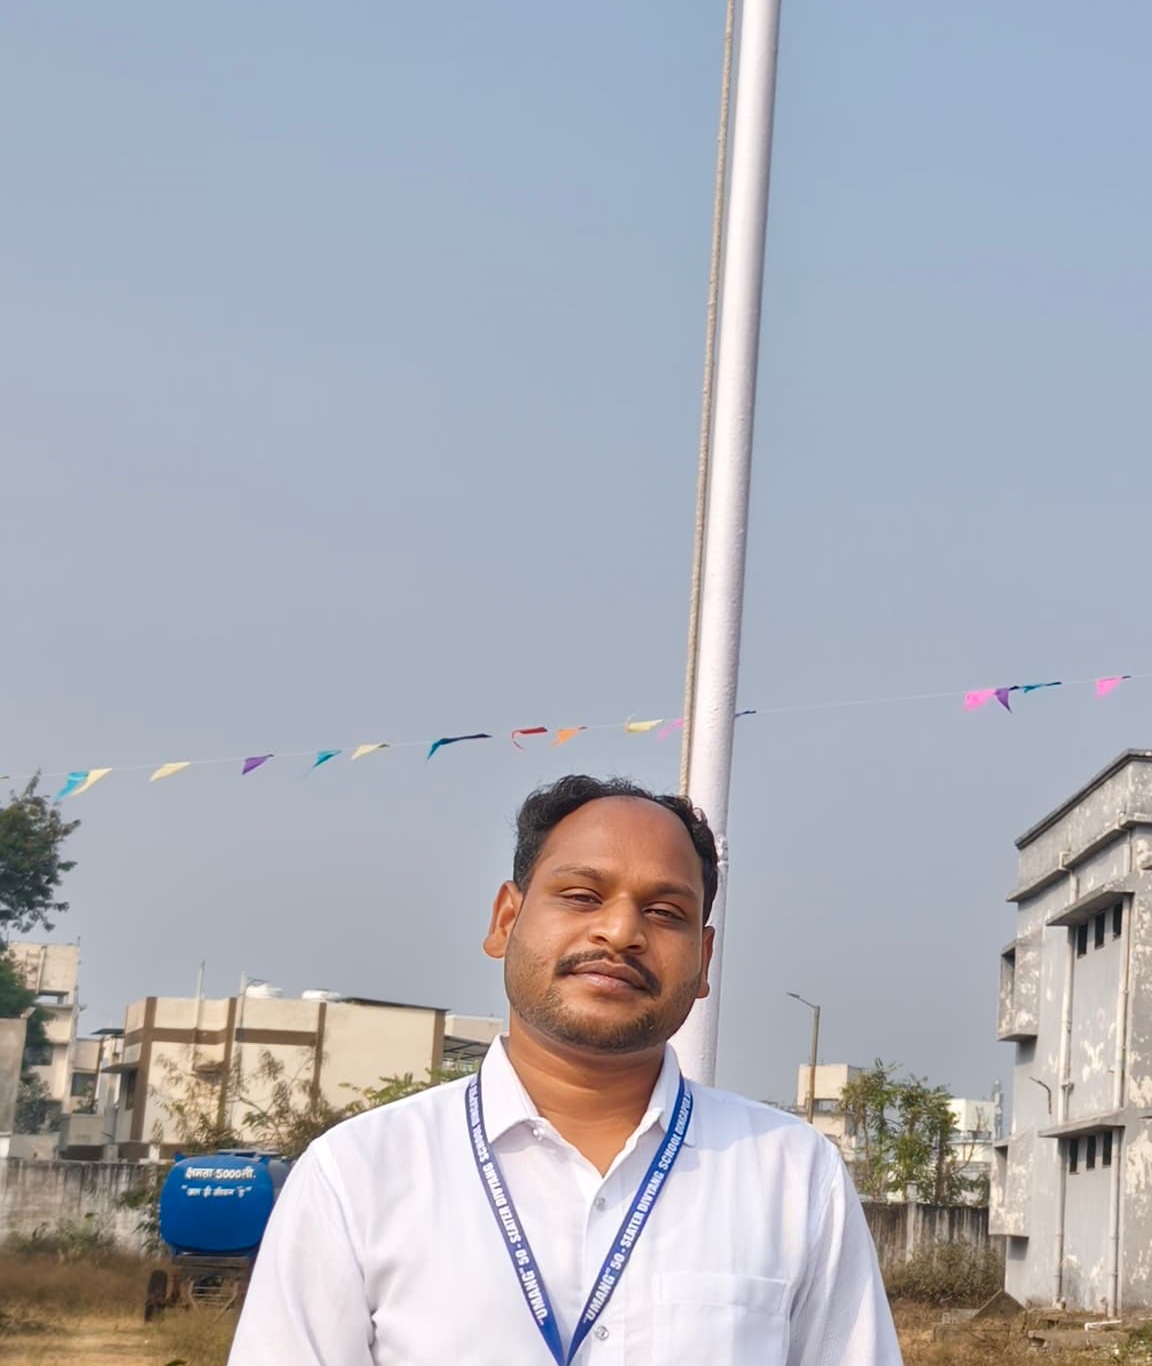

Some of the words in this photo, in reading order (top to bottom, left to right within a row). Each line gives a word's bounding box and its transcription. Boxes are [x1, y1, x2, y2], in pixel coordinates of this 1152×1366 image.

[185, 1166, 214, 1179] क्षमता
[483, 1162, 508, 1207] DIVYANG
[498, 1206, 522, 1244] SEATER
[583, 1267, 615, 1323] "UMANG"
[610, 1252, 625, 1270] 50
[620, 1211, 646, 1248] SEATER
[637, 1170, 665, 1213] DIVYANG
[658, 1133, 682, 1170] SCHOOL
[515, 1248, 530, 1266] 50
[518, 1267, 548, 1325] "UMANG"
